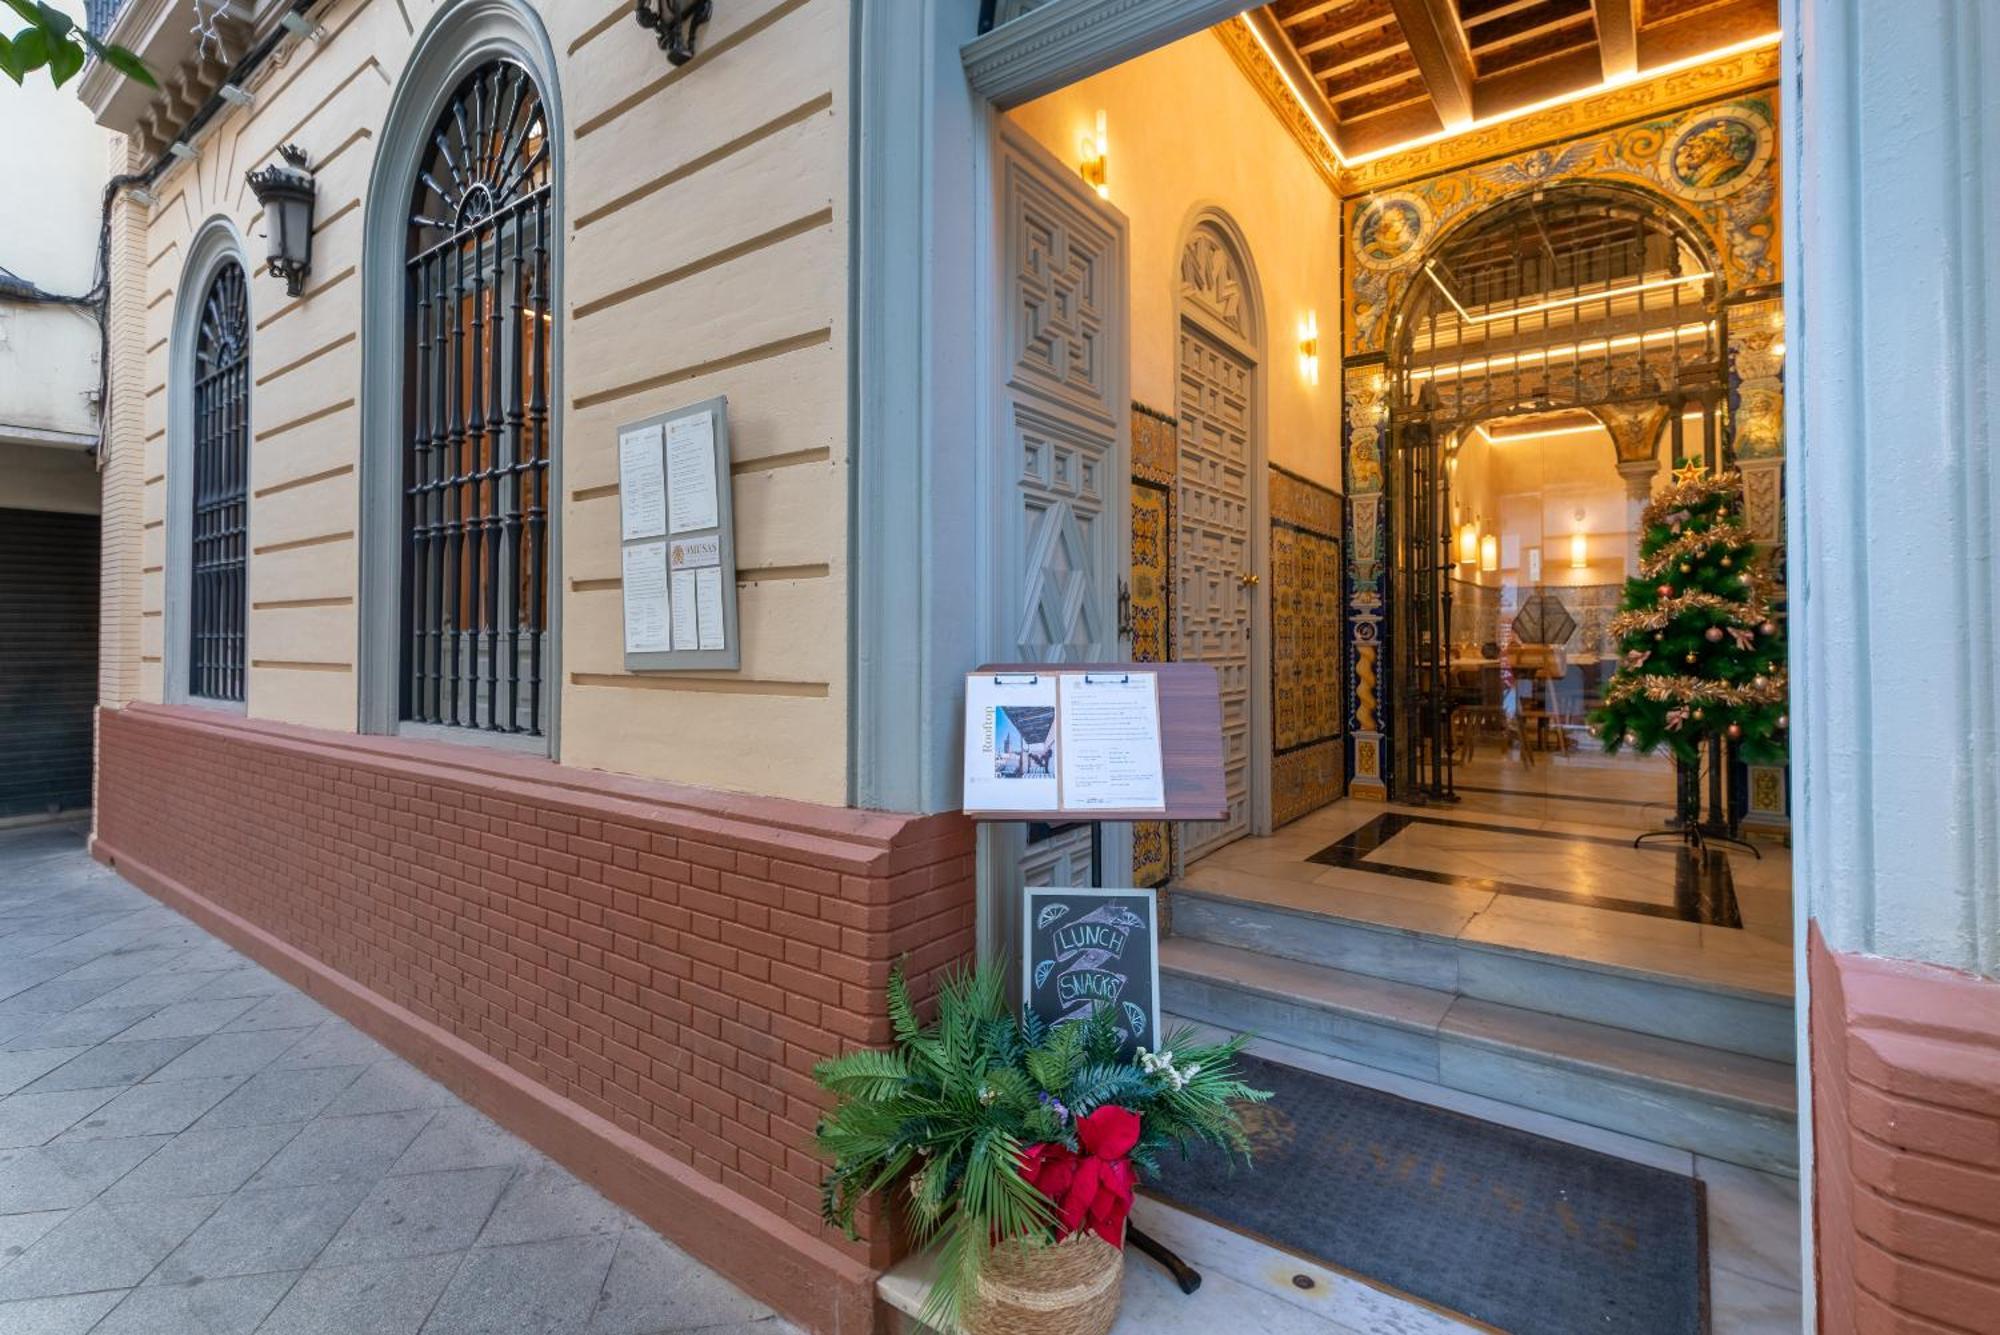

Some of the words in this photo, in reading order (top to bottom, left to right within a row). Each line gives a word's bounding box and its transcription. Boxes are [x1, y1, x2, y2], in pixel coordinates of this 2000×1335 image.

[982, 705, 995, 753] Rooftop
[1059, 925, 1124, 953] LUNCH
[1060, 973, 1120, 999] SNACKS
